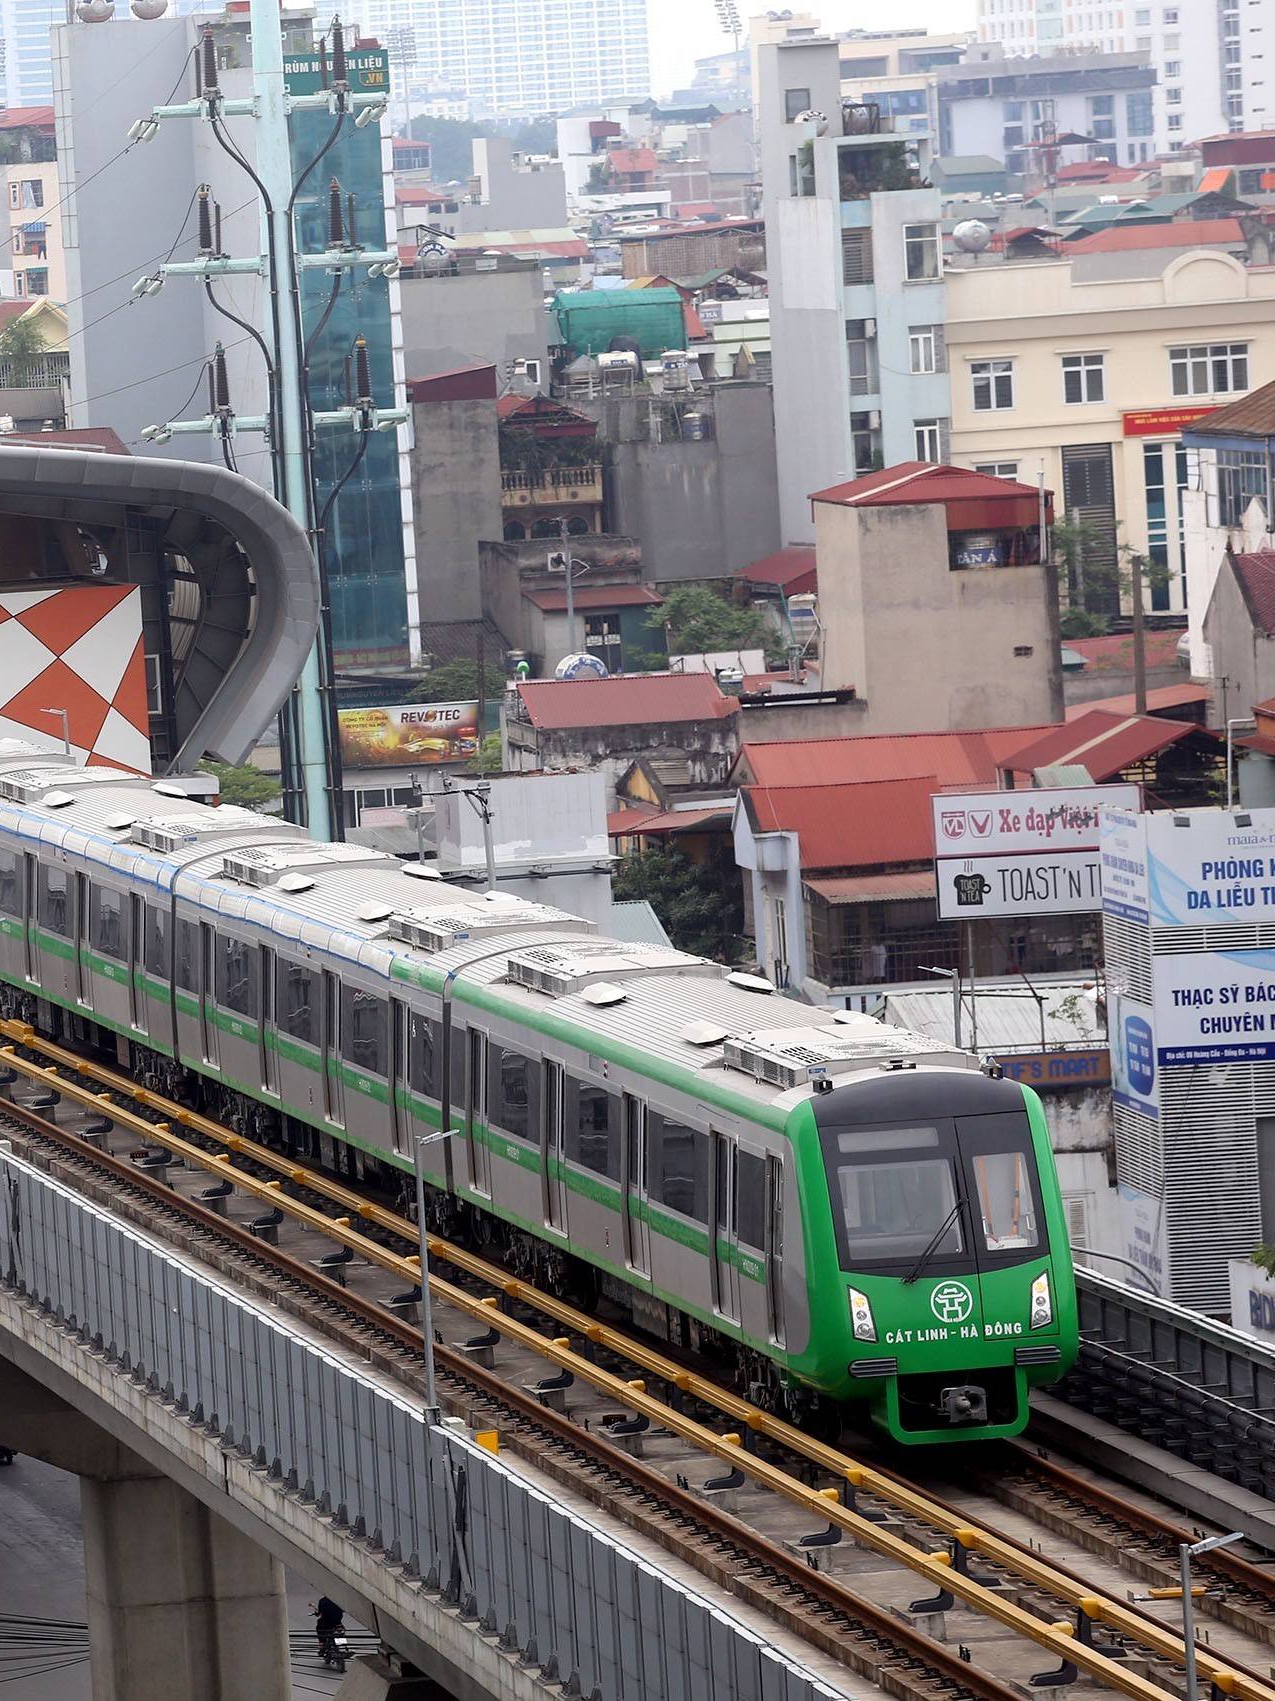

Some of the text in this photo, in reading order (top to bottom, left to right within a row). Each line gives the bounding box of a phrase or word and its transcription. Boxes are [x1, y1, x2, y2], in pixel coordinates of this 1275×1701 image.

[284, 60, 309, 74] RÙM
[358, 55, 382, 71] LIỆU
[400, 709, 460, 724] REVOTEC
[999, 809, 1021, 833] Xe
[1025, 807, 1055, 837] đạp
[1085, 864, 1102, 897] T
[1201, 856, 1264, 881] PHÒNG
[960, 878, 980, 891] TOAST
[1187, 881, 1275, 909] DA LIỄU T
[1172, 988, 1213, 1009] THẠC
[1219, 984, 1239, 1004] SỸ
[1200, 1011, 1265, 1034] CHUYÊN
[885, 1327, 912, 1344] CÁT
[917, 1327, 948, 1342] LINH
[960, 1323, 978, 1338] HÀ
[984, 1321, 1022, 1336] ĐÔNG
